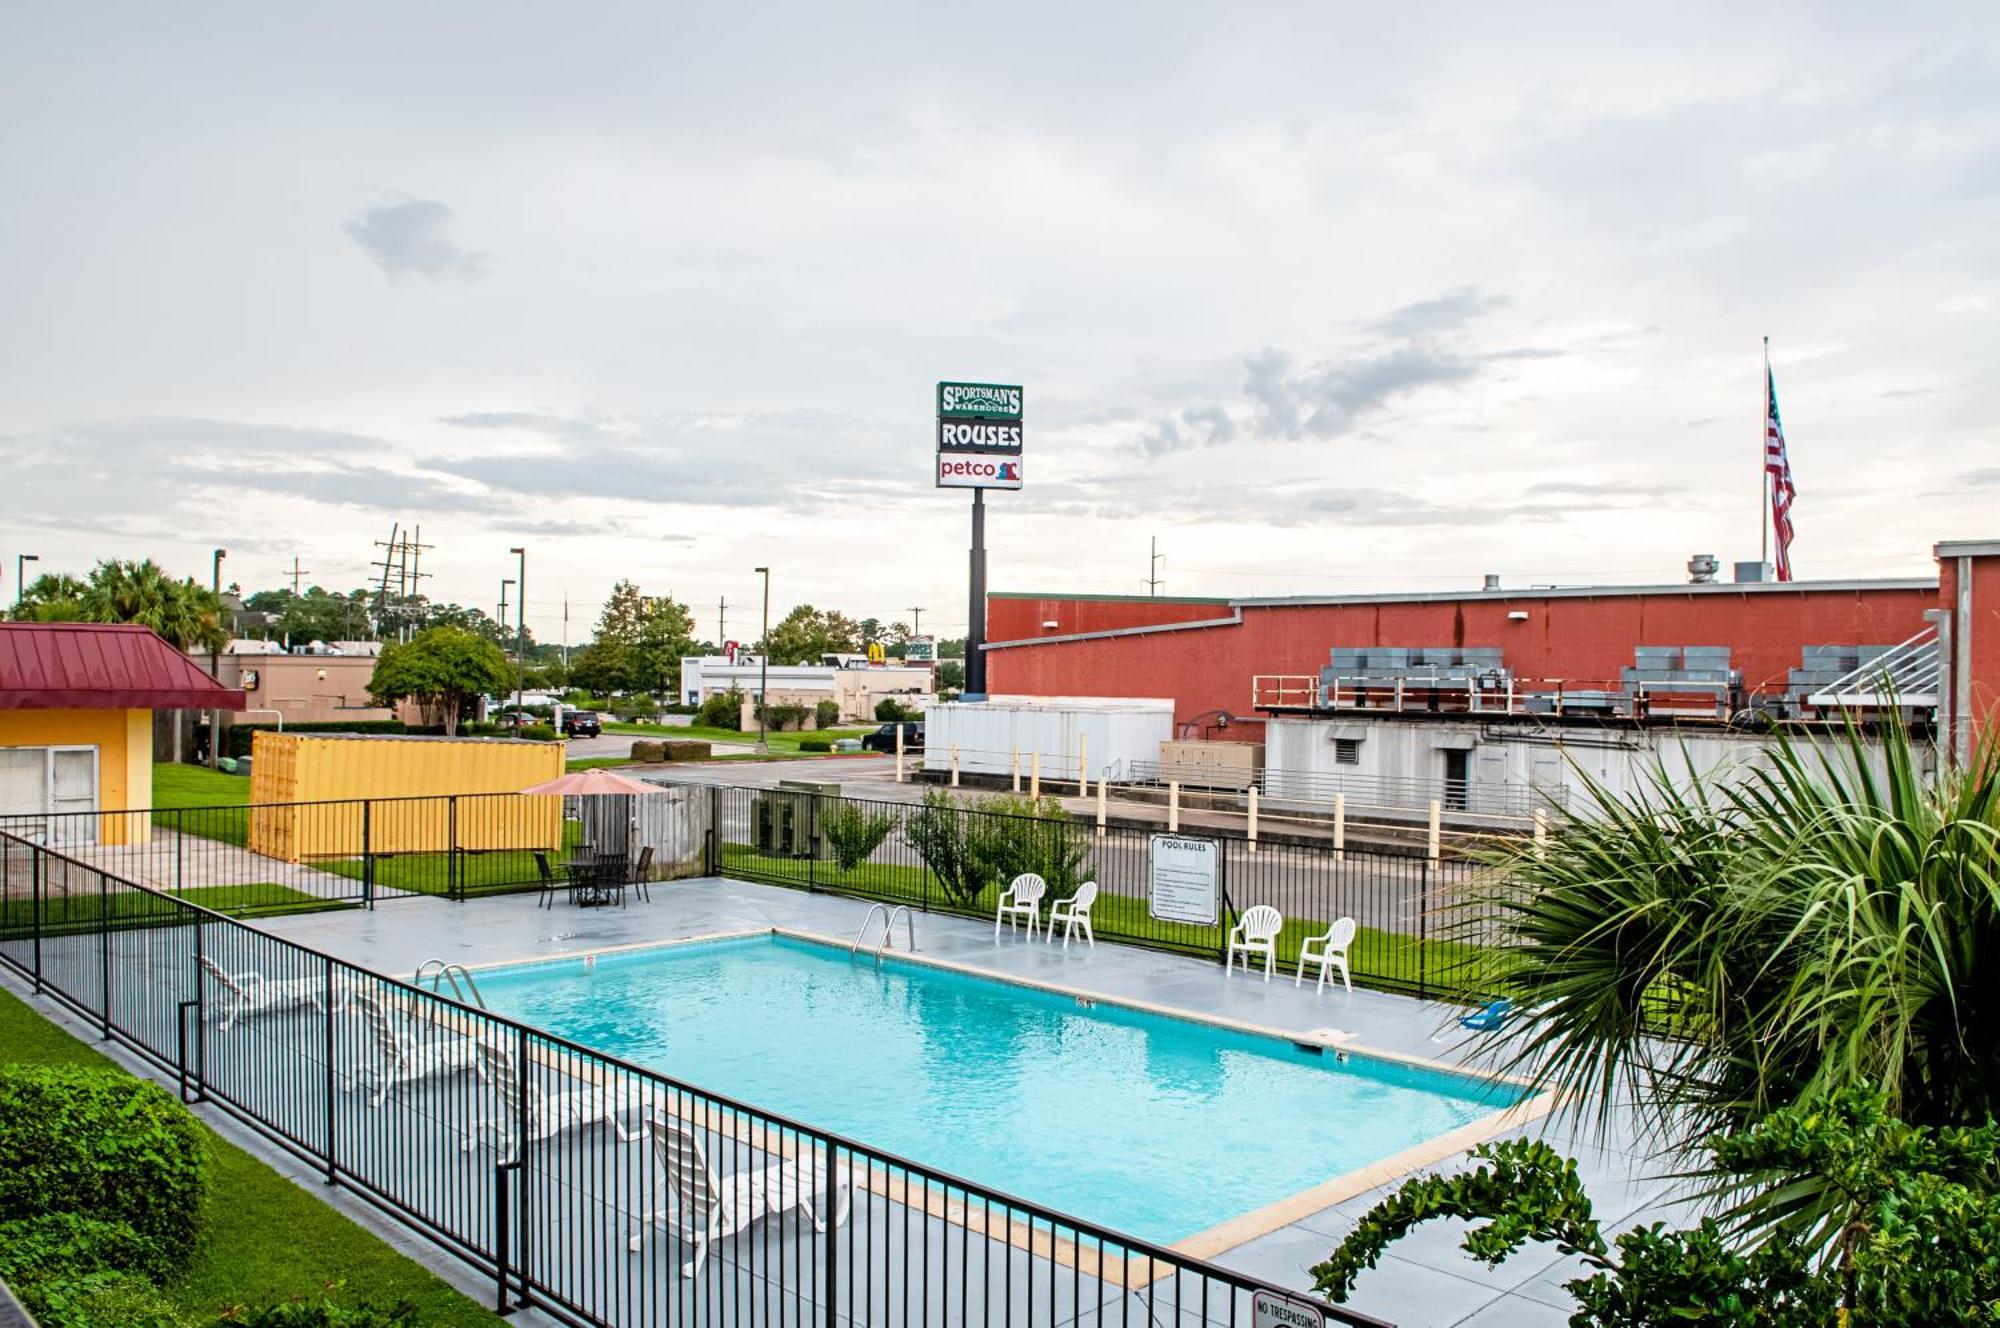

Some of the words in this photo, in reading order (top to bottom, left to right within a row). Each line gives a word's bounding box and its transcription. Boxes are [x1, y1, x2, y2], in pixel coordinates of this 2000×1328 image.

[943, 386, 1020, 414] SPORTSMAN'S
[954, 404, 1009, 413] WAREHOUSE
[942, 424, 1021, 446] ROUSES
[941, 461, 996, 478] petco
[1162, 840, 1182, 849] POOL
[1183, 842, 1207, 851] RULES
[1257, 1301, 1268, 1314] NO
[1270, 1304, 1318, 1328] TRESPASSING
